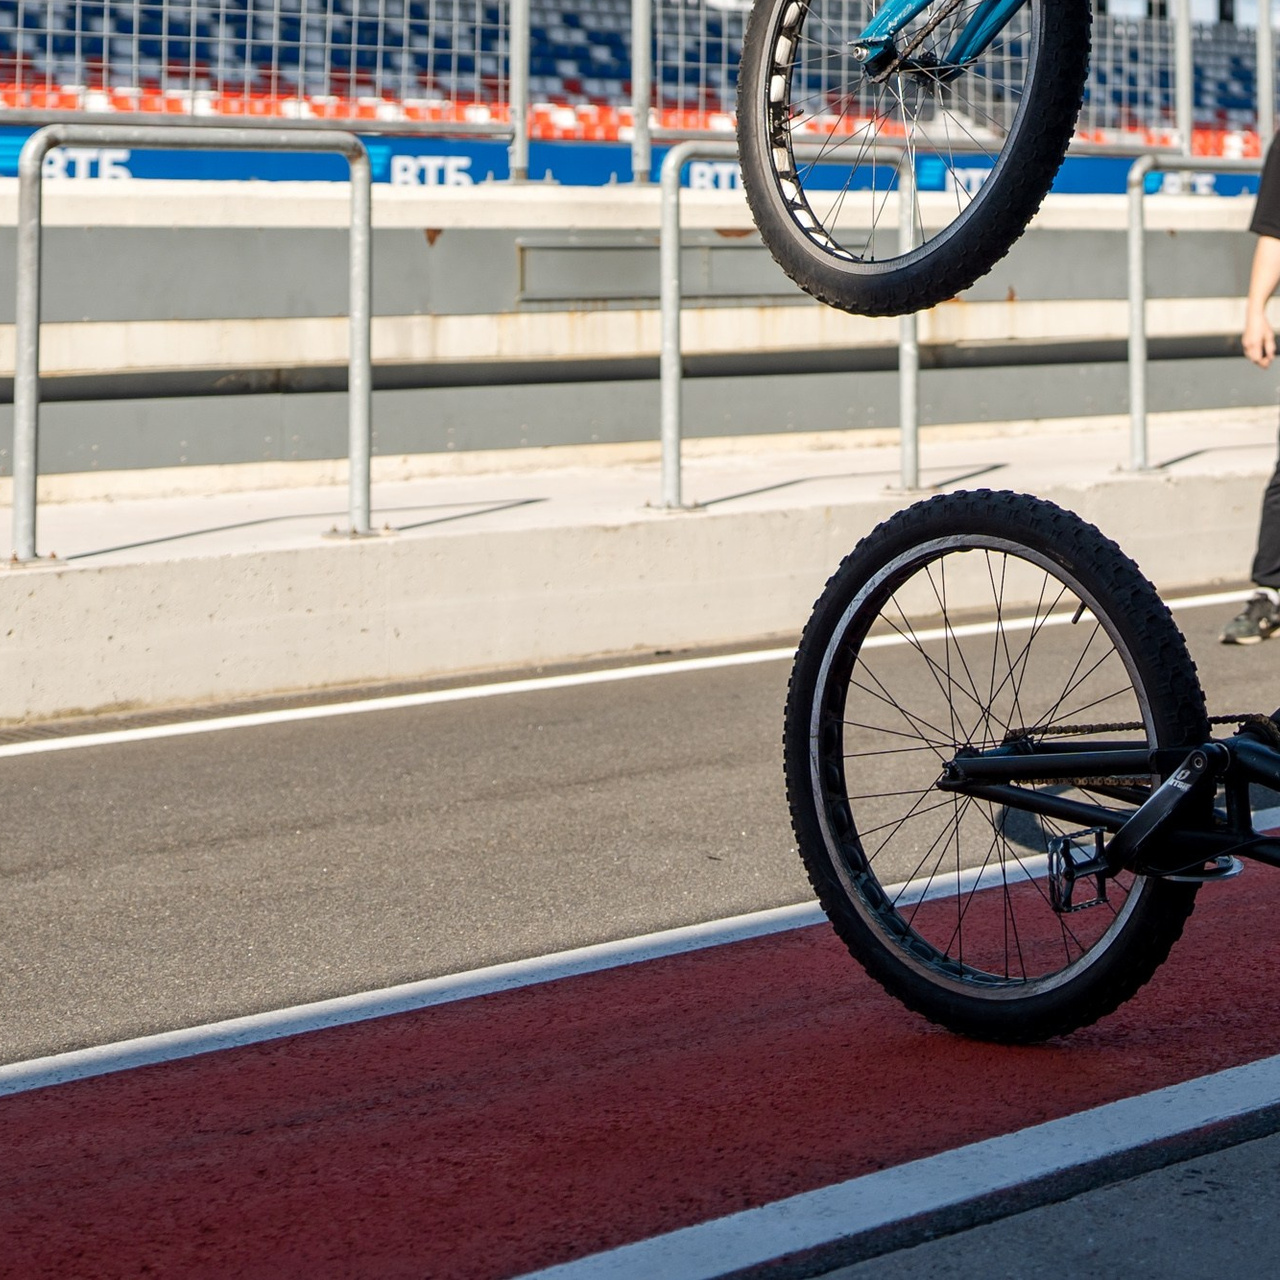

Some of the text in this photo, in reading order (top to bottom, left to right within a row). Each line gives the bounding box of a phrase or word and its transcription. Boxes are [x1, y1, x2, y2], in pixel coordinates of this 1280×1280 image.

[42, 147, 133, 178] ВТБ
[391, 155, 473, 185] ВТБ
[690, 162, 743, 188] ВТ
